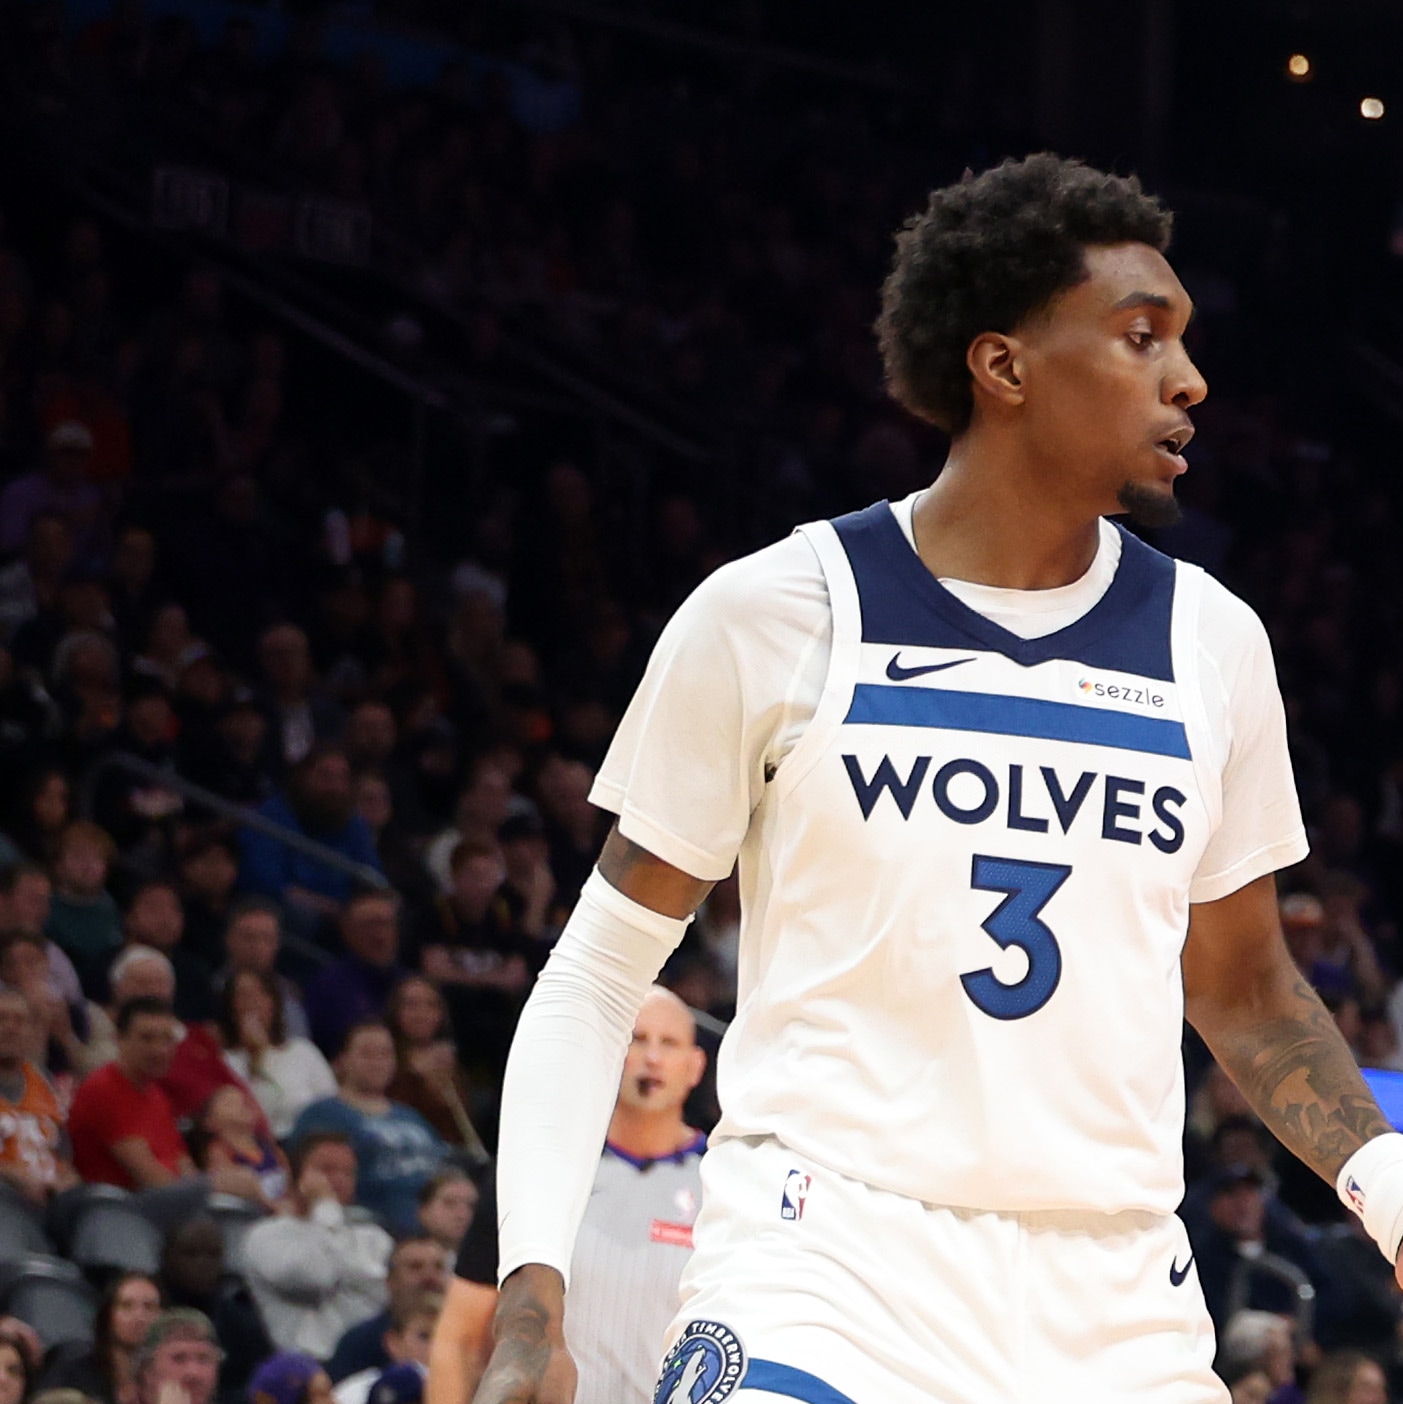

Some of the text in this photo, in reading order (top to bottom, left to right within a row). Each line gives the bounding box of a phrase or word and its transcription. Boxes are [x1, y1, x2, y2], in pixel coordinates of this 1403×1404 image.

[1094, 680, 1165, 708] sezzle
[841, 753, 1188, 855] WOLVES
[959, 853, 1074, 1021] 3
